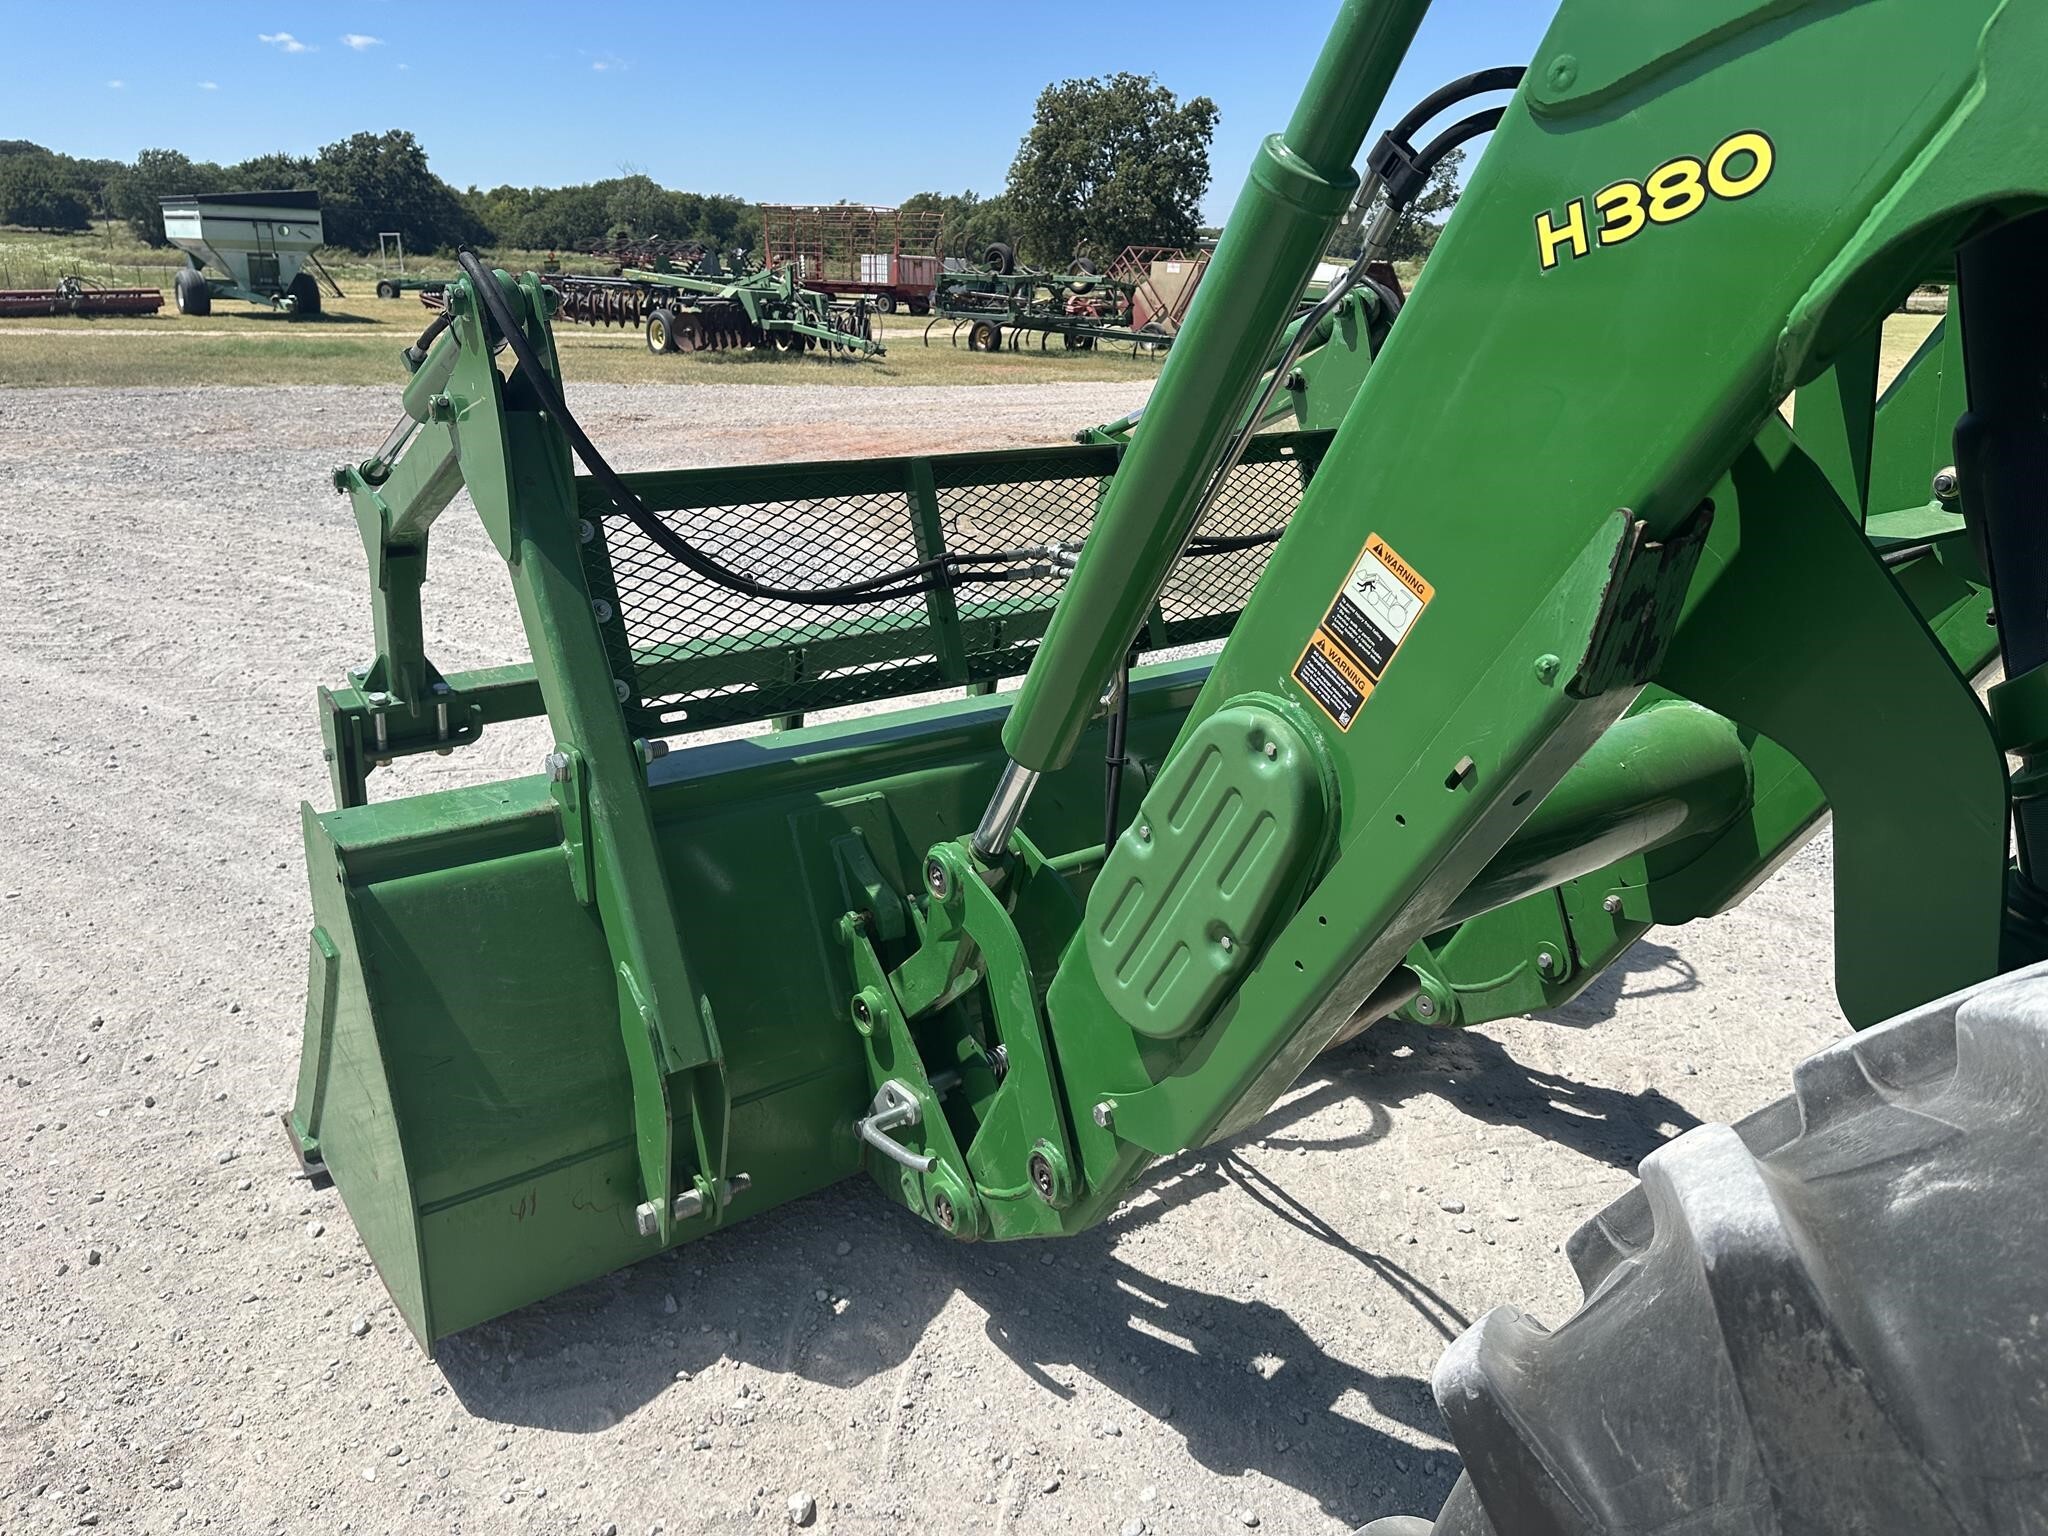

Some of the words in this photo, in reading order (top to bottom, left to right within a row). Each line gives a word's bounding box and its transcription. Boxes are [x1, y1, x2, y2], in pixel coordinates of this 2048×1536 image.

[1535, 129, 1775, 271] H380
[1382, 551, 1426, 595] WARNING
[1327, 648, 1366, 690] WARNING
